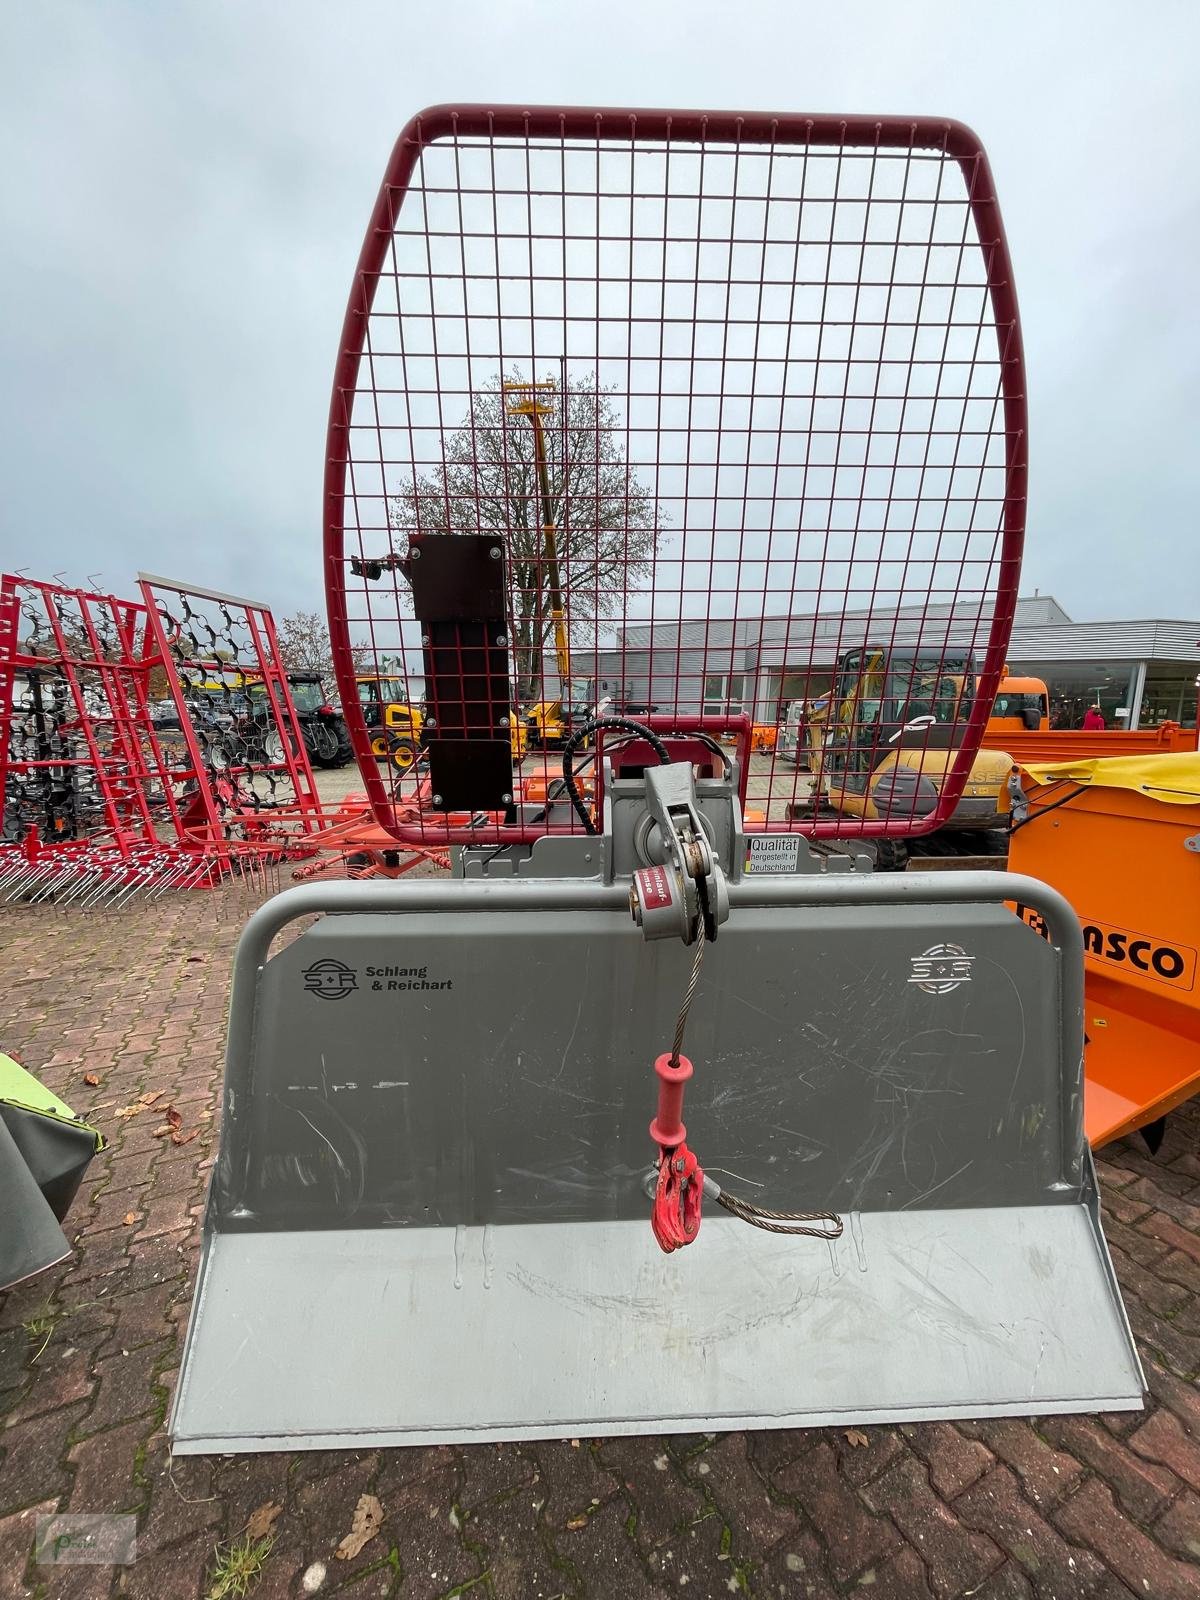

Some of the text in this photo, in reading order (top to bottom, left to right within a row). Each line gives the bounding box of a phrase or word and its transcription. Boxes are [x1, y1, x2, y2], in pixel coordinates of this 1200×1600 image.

[752, 839, 797, 851] Qualität
[751, 853, 788, 861] hergestellt
[751, 863, 795, 872] Deutschland
[1082, 925, 1184, 979] ASCO
[366, 966, 428, 979] Schlang
[371, 979, 453, 991] & Reichart
